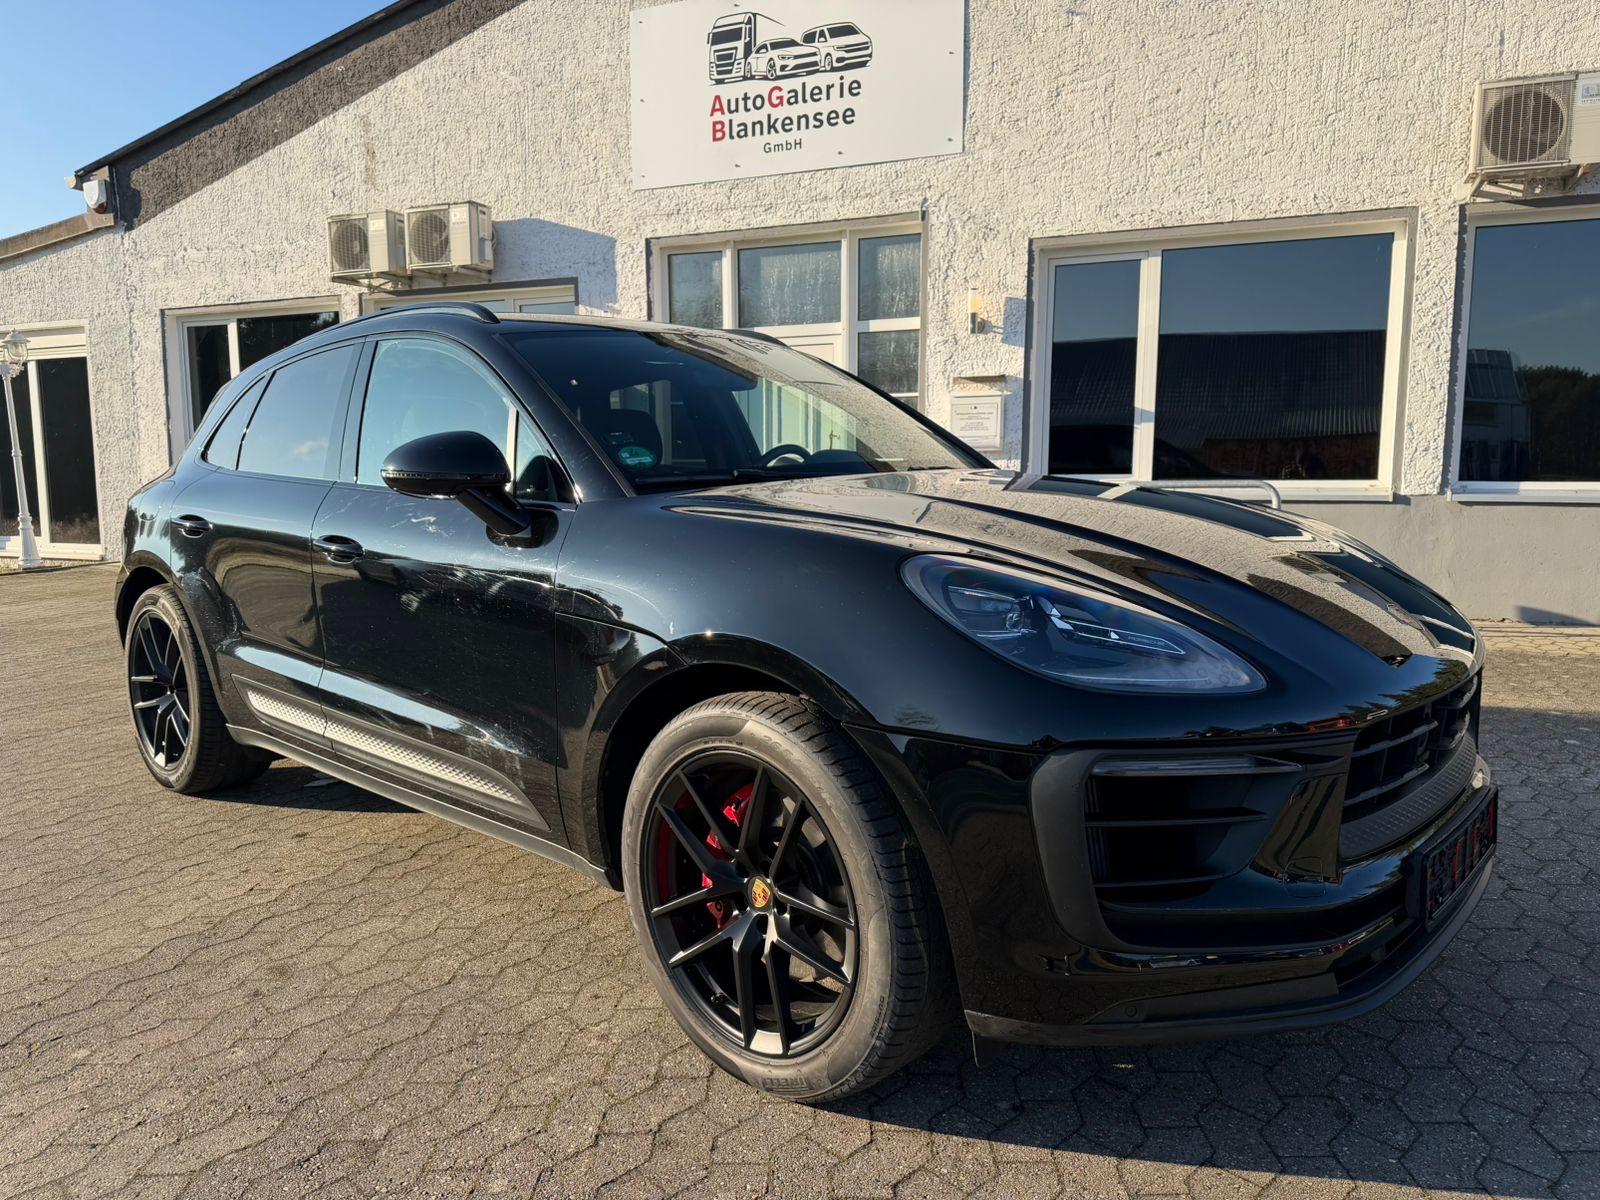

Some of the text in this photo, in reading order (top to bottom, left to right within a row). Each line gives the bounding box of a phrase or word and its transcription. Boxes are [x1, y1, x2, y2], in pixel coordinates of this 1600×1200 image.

[709, 75, 862, 117] AutoGalerie
[712, 107, 856, 142] Blankensee
[763, 138, 802, 153] GmbH
